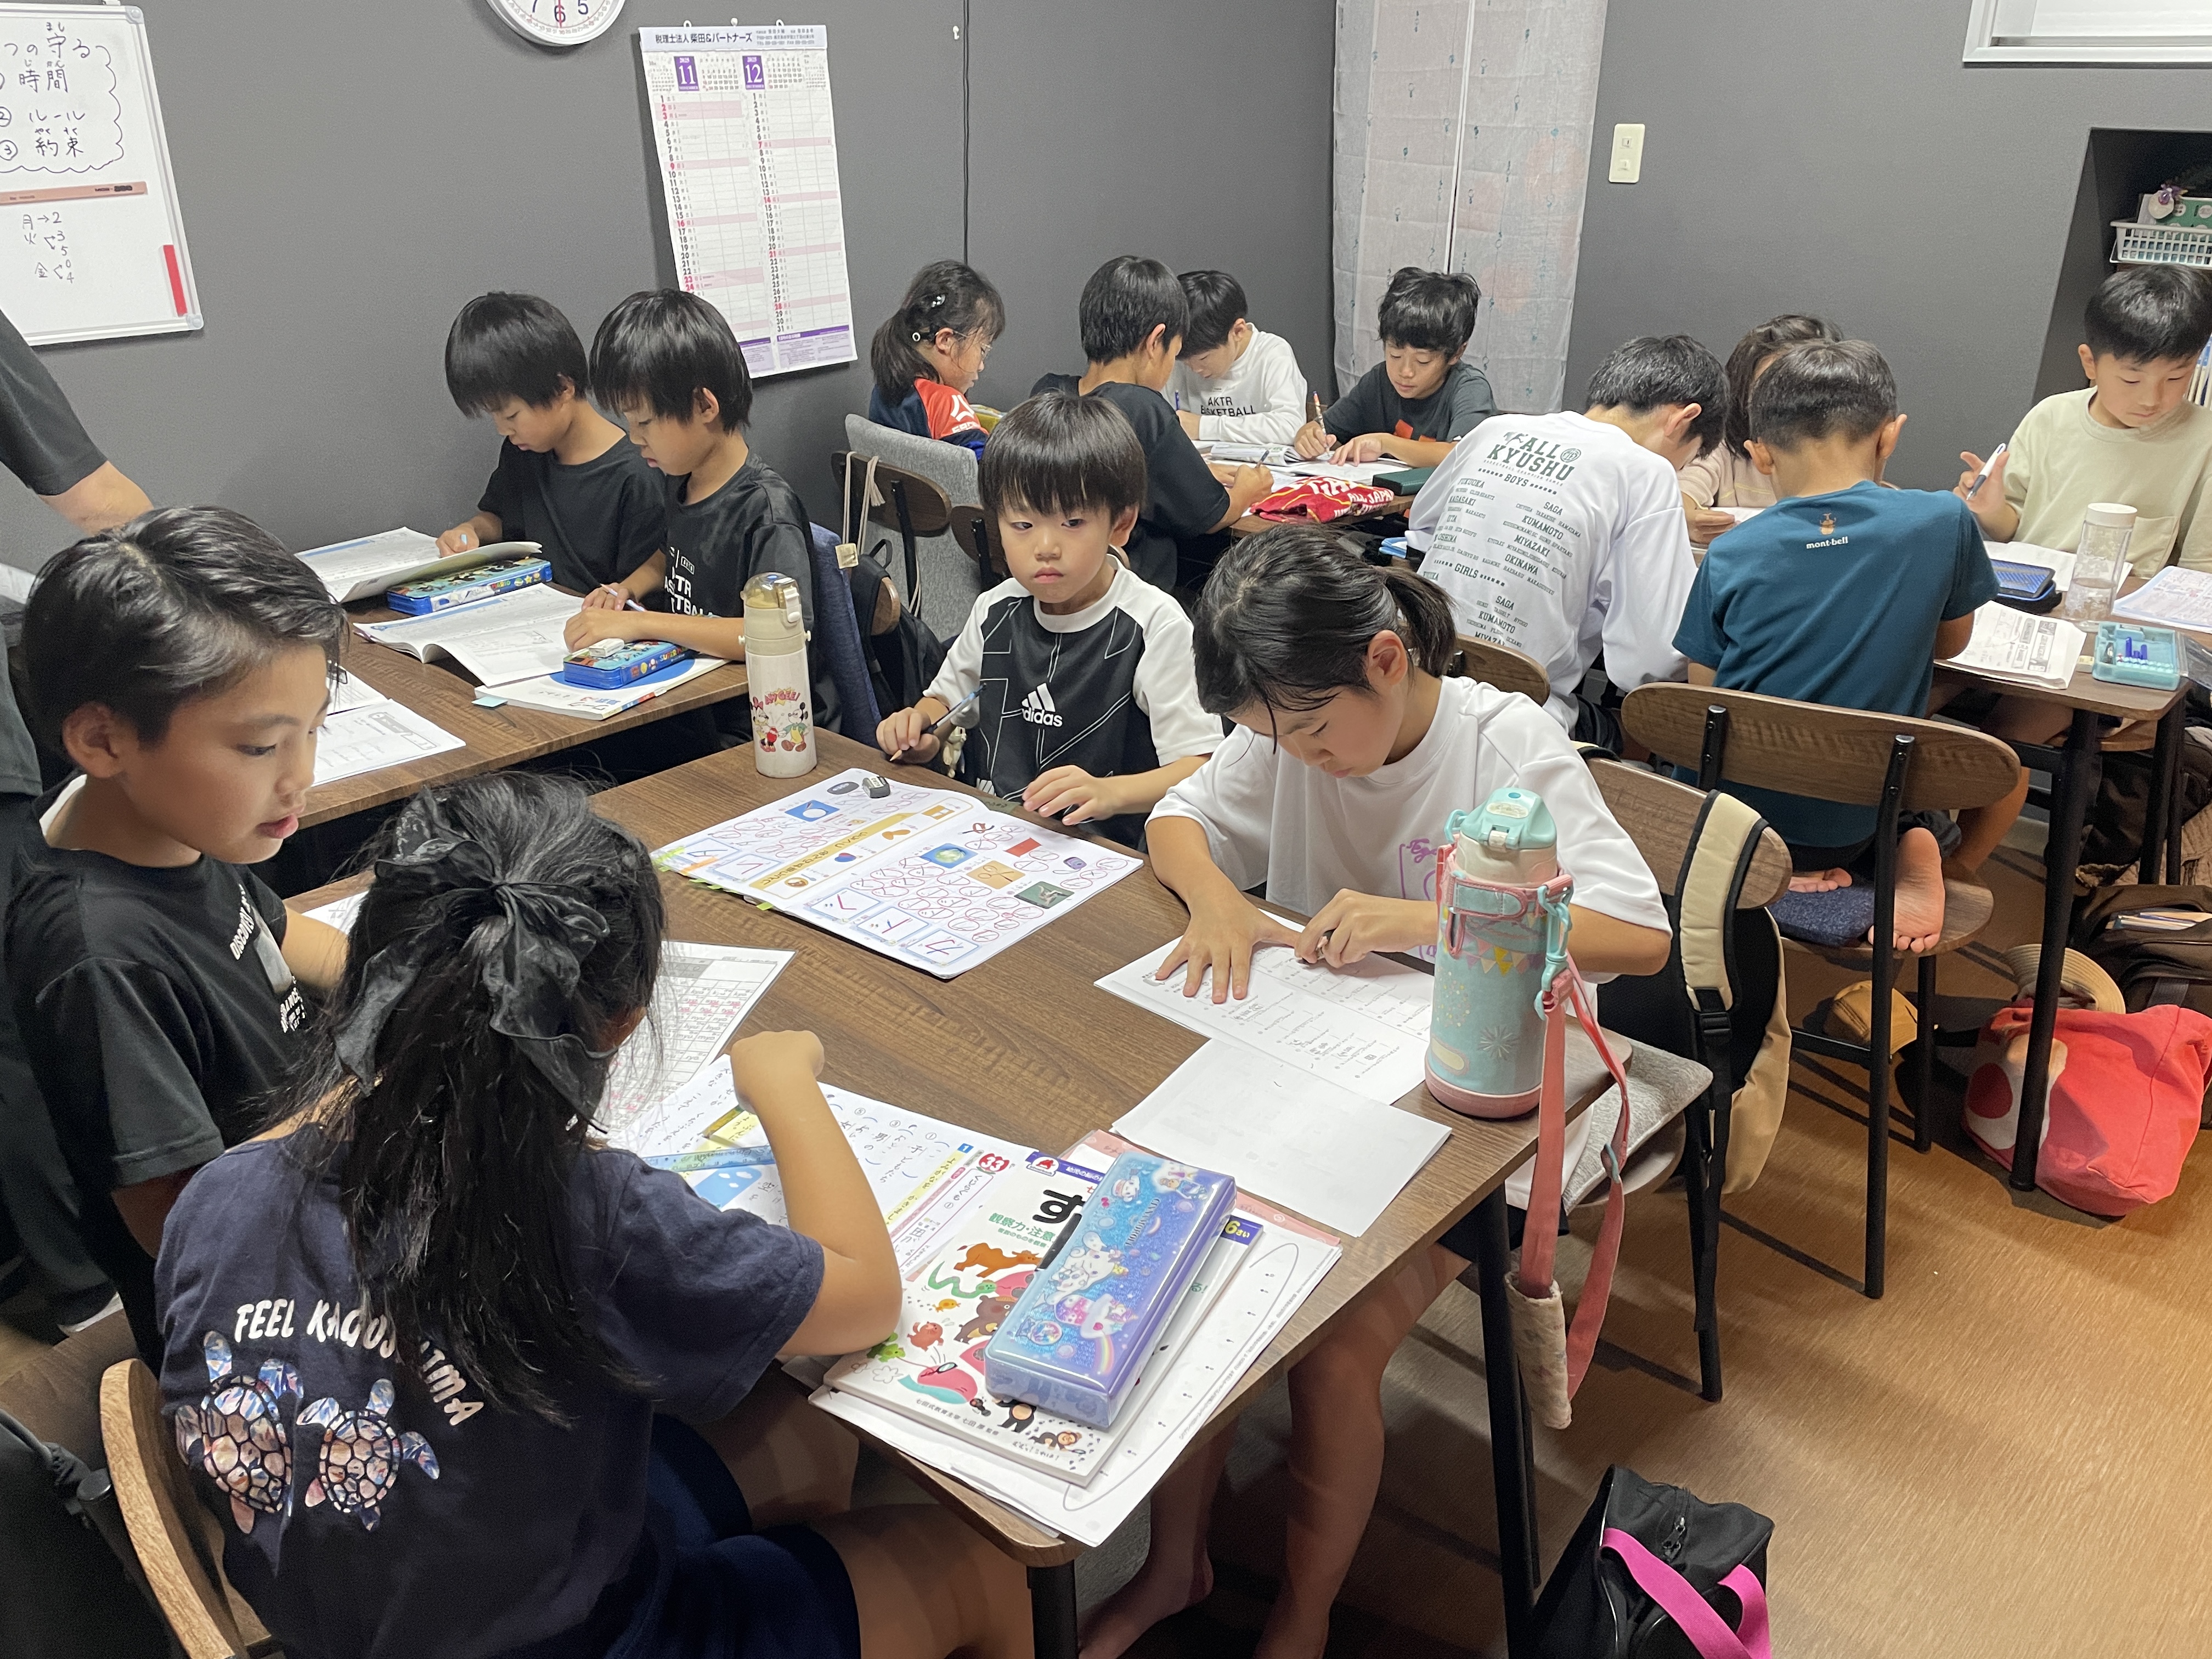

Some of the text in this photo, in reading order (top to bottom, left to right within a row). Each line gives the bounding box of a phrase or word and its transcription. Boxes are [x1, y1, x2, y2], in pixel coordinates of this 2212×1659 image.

[554, 5, 566, 22] 6
[19, 69, 68, 93] 時間
[679, 65, 696, 84] 11
[745, 64, 763, 83] 12
[29, 109, 86, 122] ルール
[35, 137, 84, 158] 約束
[22, 212, 61, 230] 月 2
[24, 230, 65, 245] 火 3
[60, 245, 68, 256] 5
[35, 262, 48, 279] 金
[67, 272, 75, 284] 4
[1208, 397, 1233, 407] AKTR
[1520, 437, 1561, 459] ALL
[1487, 444, 1575, 481] KYUSHU
[1504, 474, 1529, 487] BOYS
[1347, 493, 1367, 503] ALL
[1543, 502, 1563, 515] SAGA
[1522, 515, 1564, 540] KUMAMOTO
[1514, 534, 1550, 557] MIYAZAKI
[1454, 563, 1479, 578] GIRLS
[1505, 554, 1538, 575] OKINAWA
[1496, 596, 1514, 610] SAGA
[1479, 611, 1515, 634] KUMAMOTO
[1022, 707, 1063, 727] adidas
[981, 1155, 1005, 1172] 33
[988, 1212, 1056, 1243] 観察力・注意
[234, 1298, 295, 1343] FEEL
